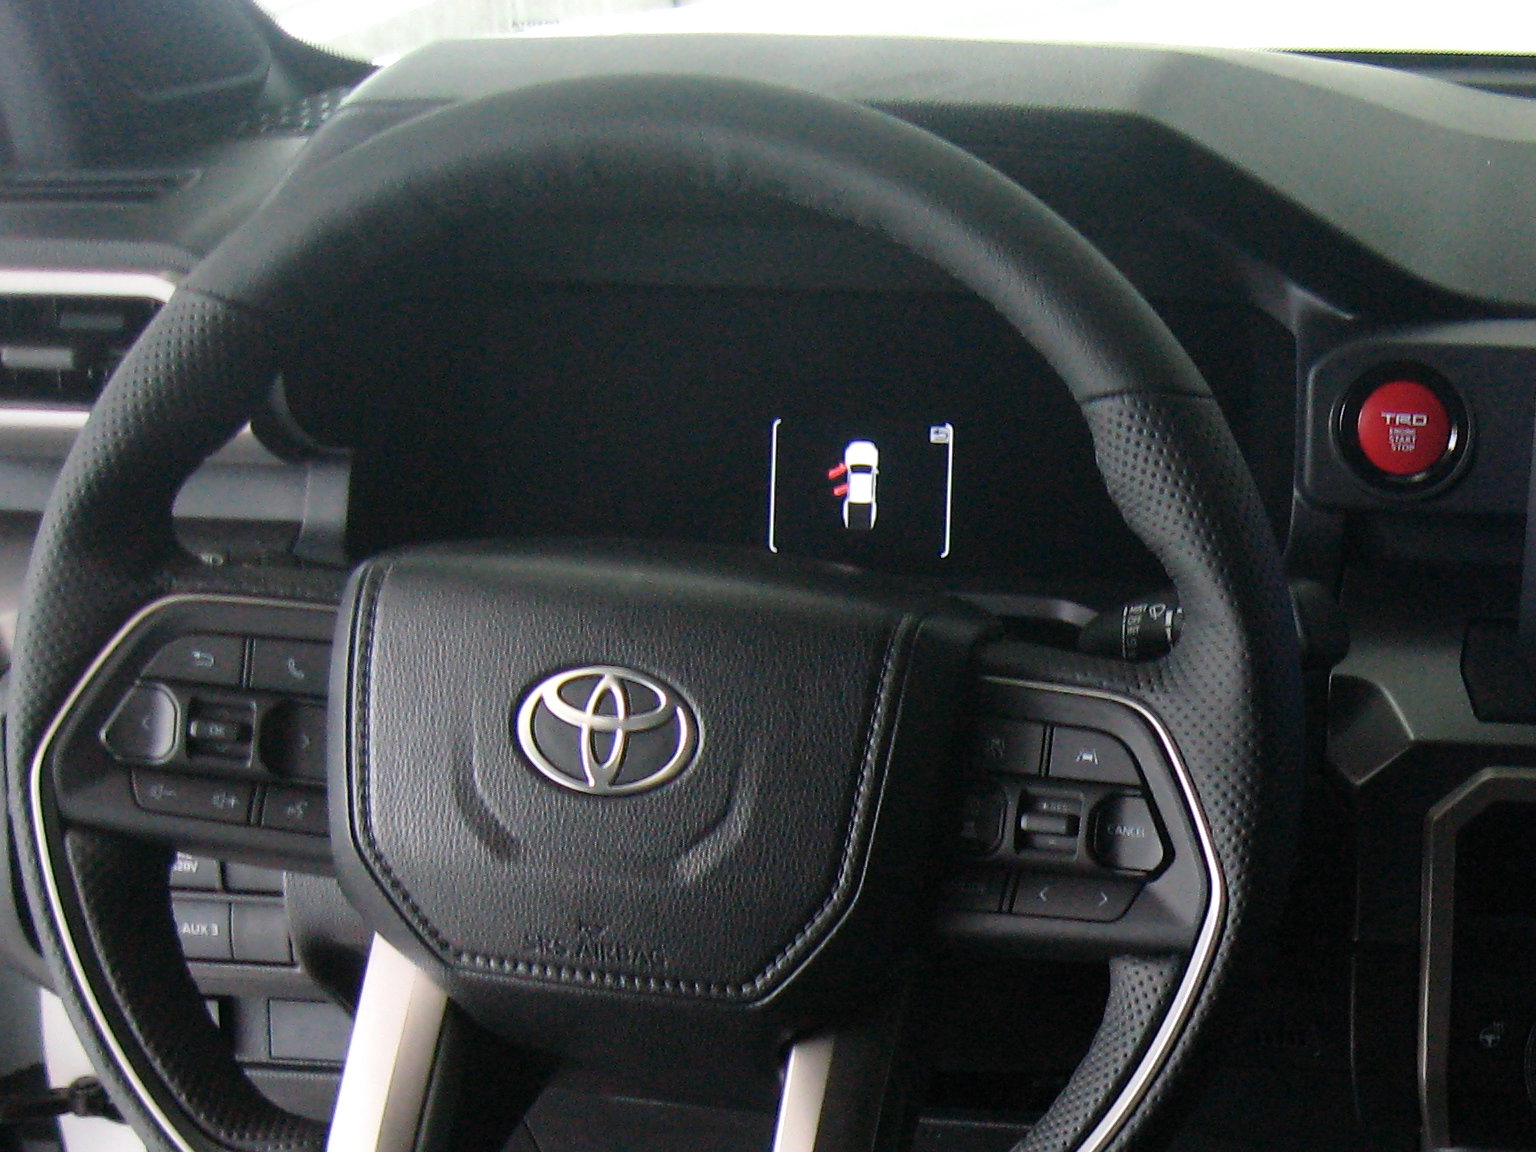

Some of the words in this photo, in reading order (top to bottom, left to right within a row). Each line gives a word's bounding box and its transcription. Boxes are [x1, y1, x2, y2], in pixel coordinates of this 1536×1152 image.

[1381, 411, 1427, 426] TRD
[1391, 442, 1415, 452] STOP
[1107, 826, 1145, 838] CANCEL
[182, 922, 208, 936] AUX
